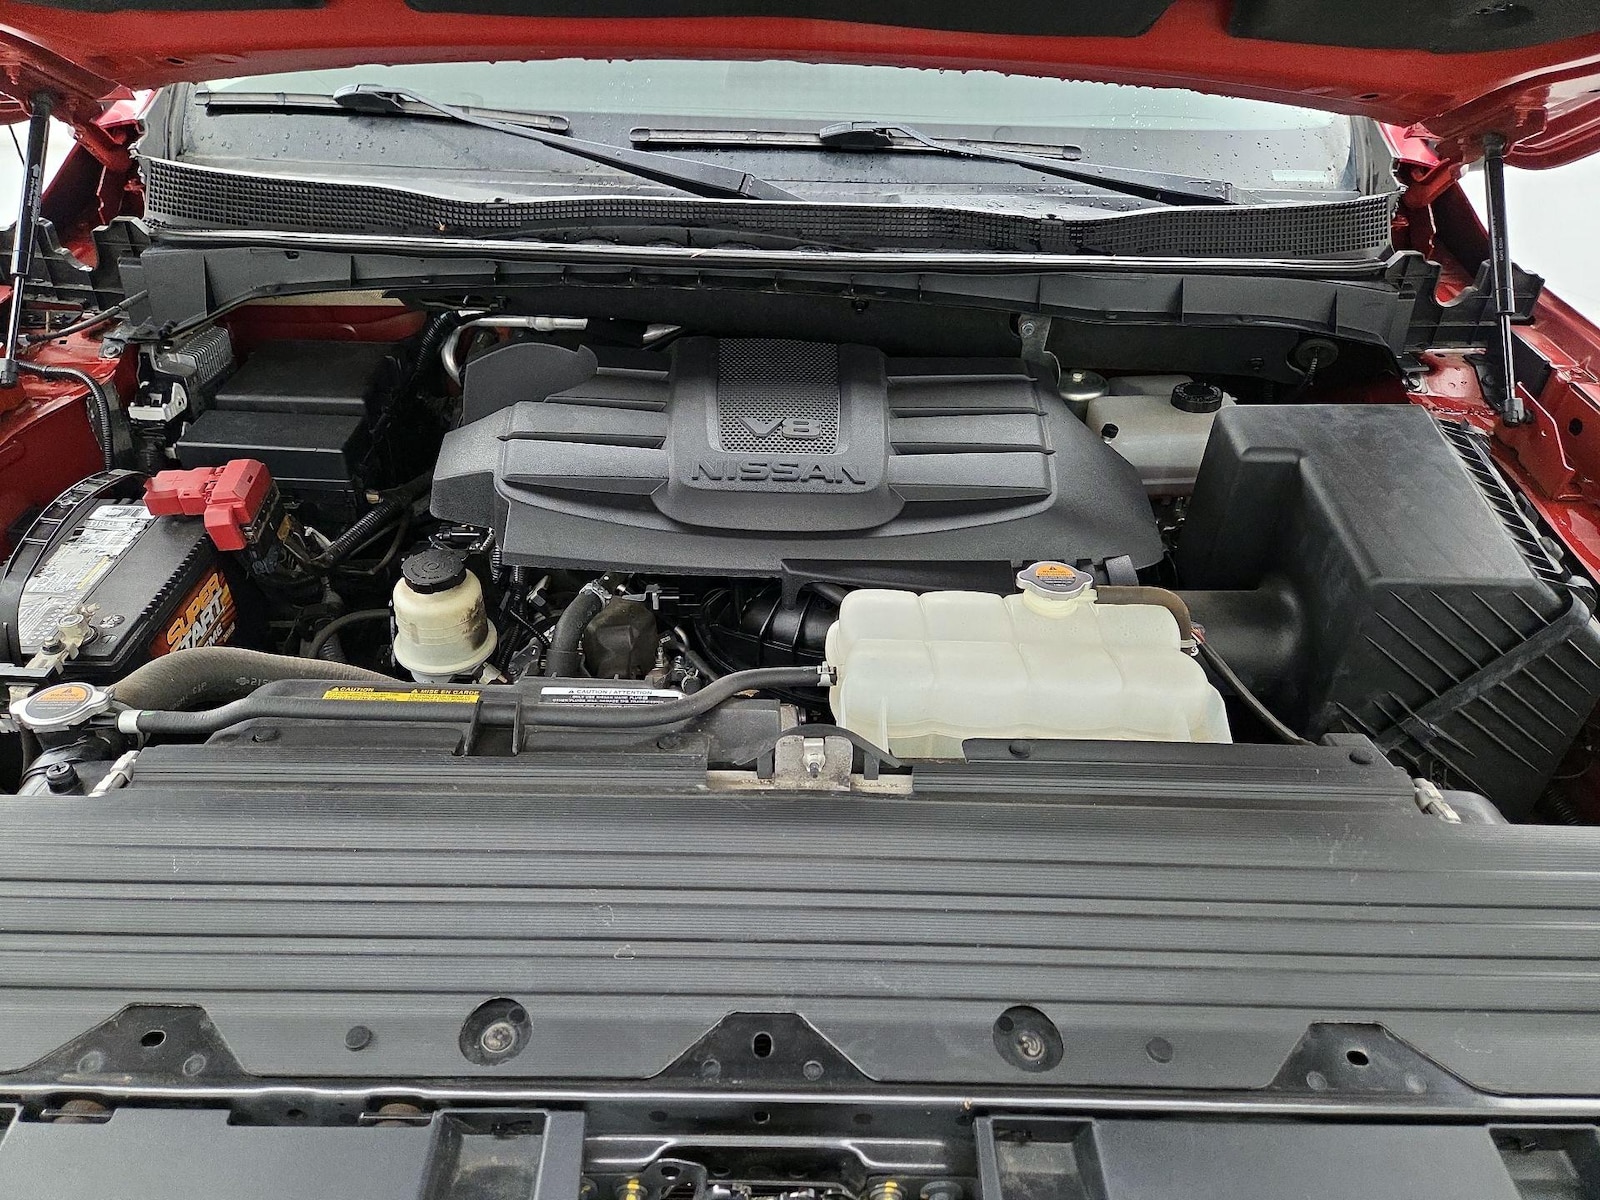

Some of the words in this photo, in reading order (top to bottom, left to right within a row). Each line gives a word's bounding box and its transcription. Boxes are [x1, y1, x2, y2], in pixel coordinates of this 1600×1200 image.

[738, 416, 821, 440] V8
[690, 458, 866, 484] NISSAN
[166, 572, 220, 645] SUPER
